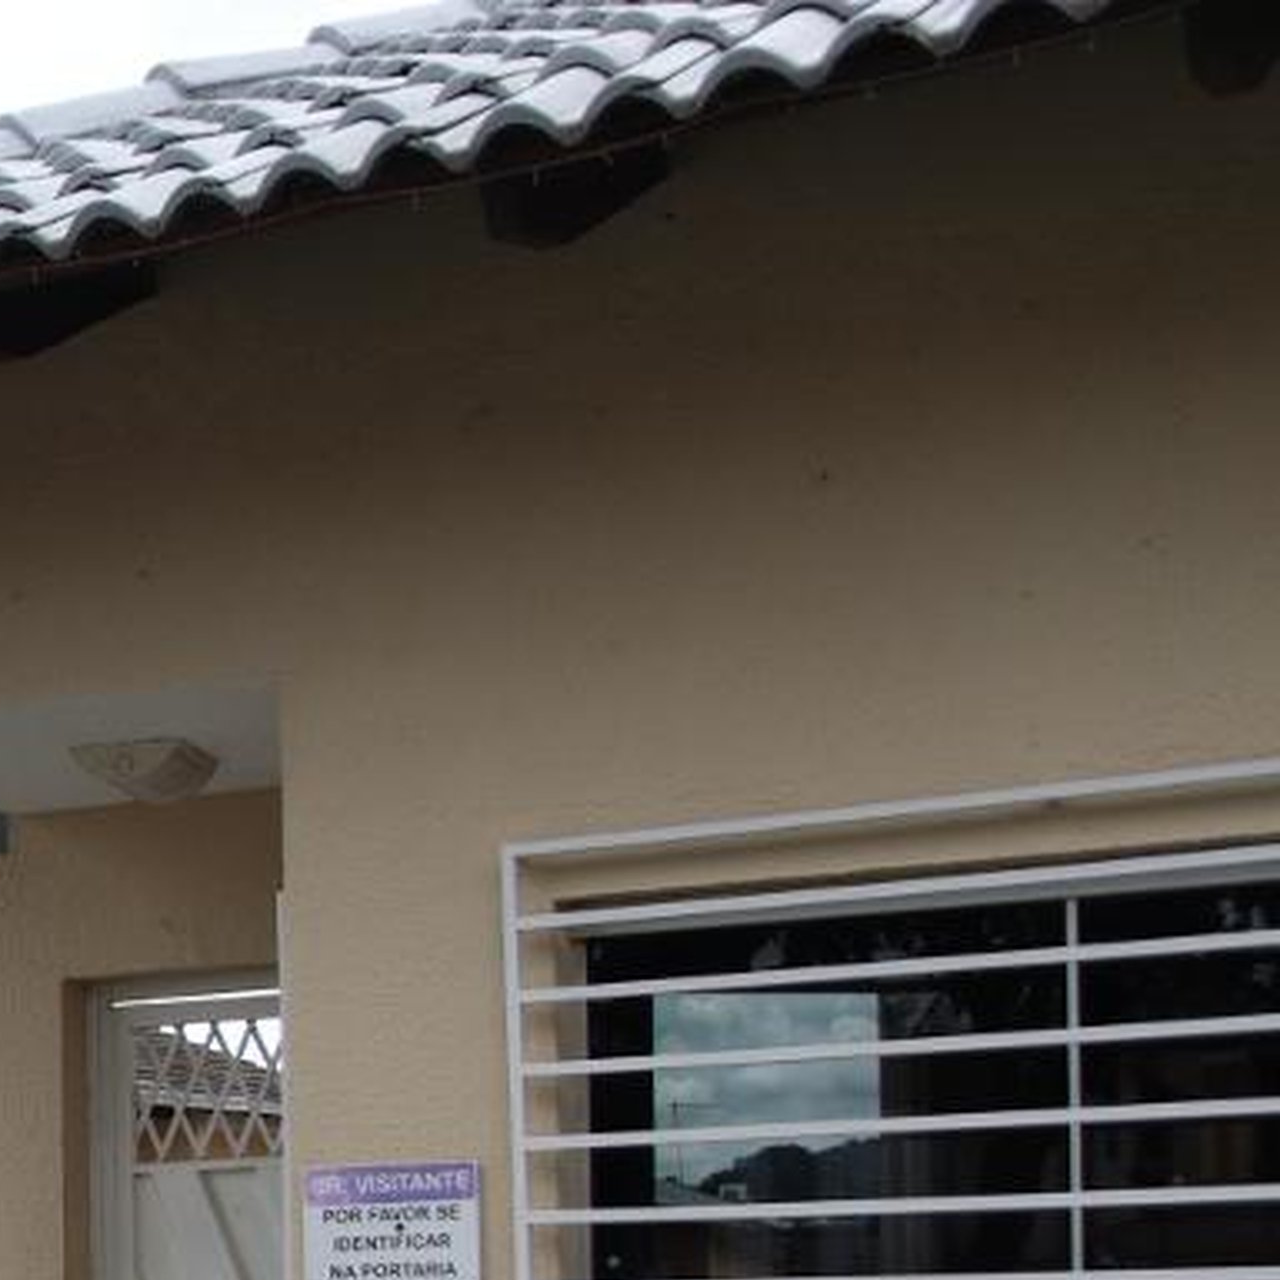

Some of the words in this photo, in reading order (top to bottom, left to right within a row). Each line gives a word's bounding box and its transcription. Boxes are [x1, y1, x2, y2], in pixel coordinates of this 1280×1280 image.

[355, 1170, 469, 1195] VISITANTE
[322, 1207, 362, 1224] POR
[368, 1204, 431, 1222] FAVOR
[437, 1203, 463, 1221] SE
[333, 1232, 452, 1252] IDENTIFICAR
[329, 1263, 357, 1280] NA
[362, 1261, 458, 1279] PORTARIA
